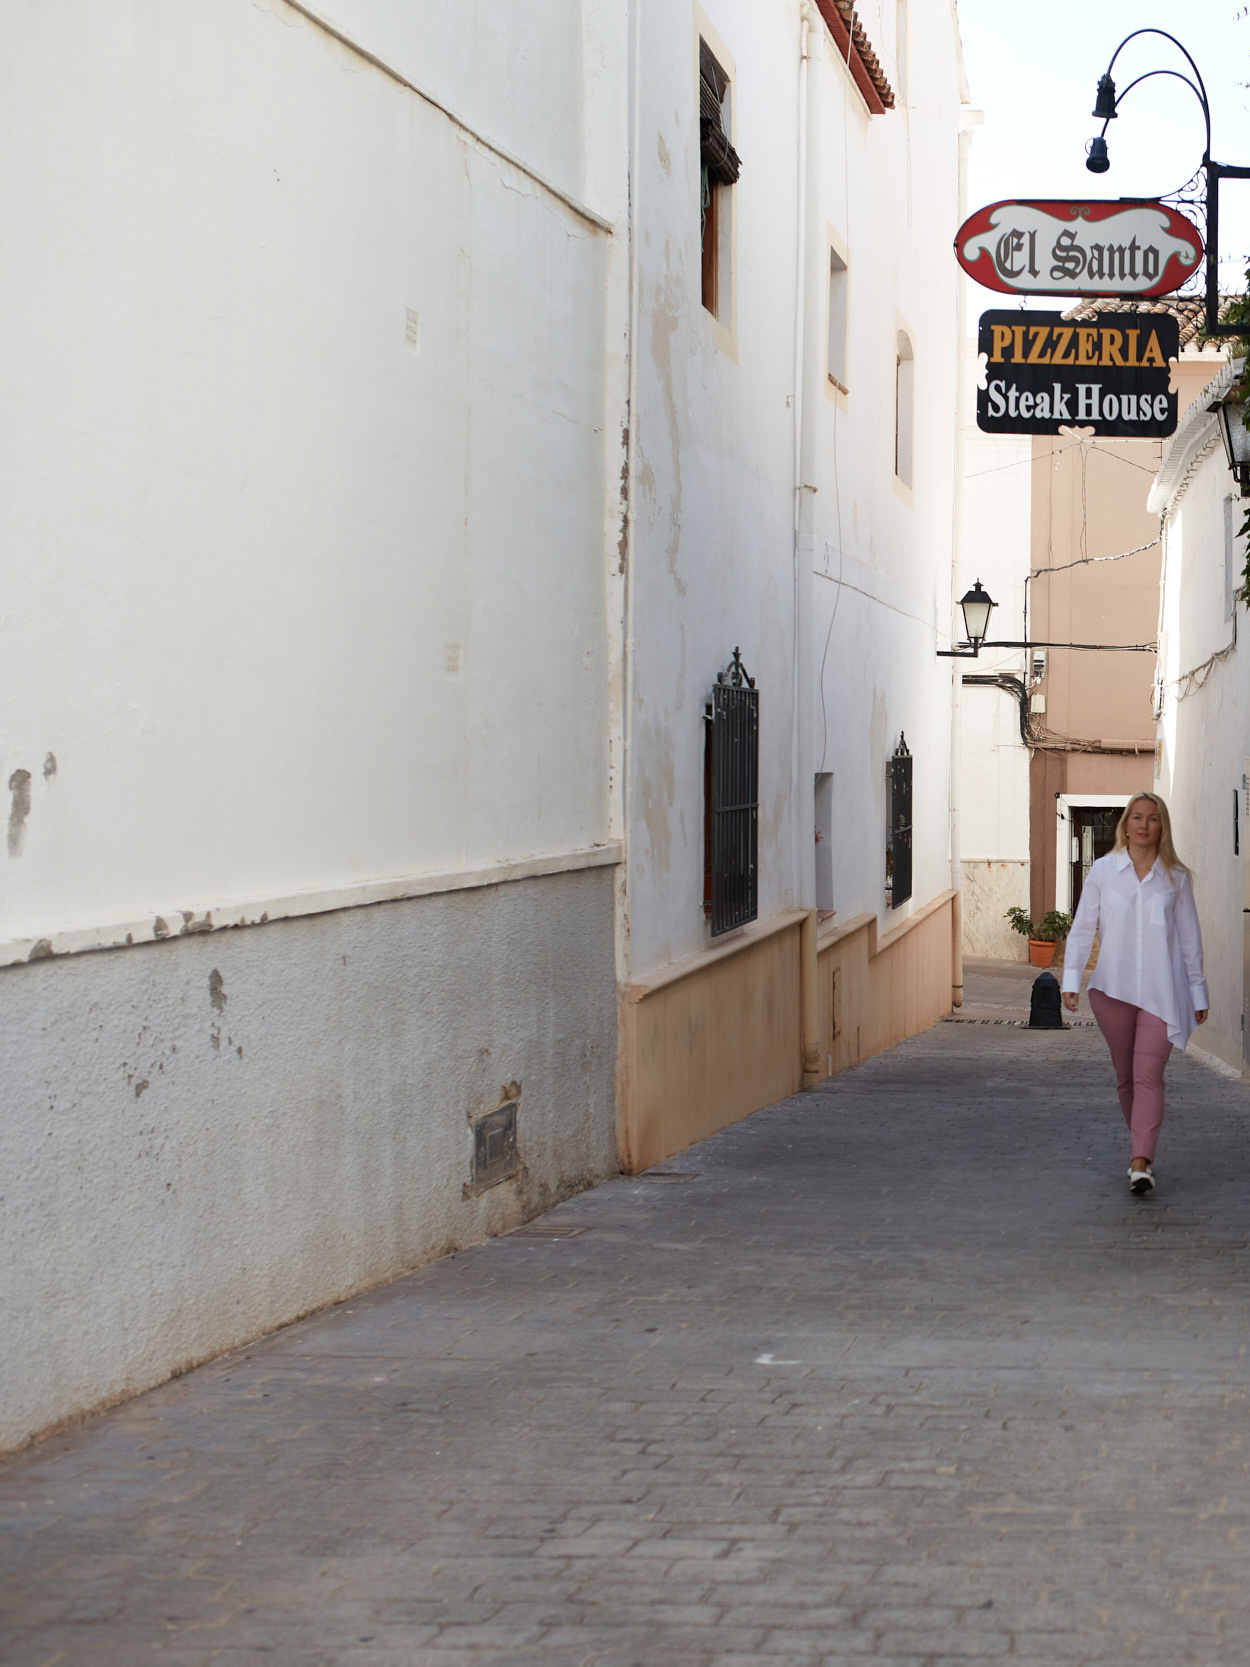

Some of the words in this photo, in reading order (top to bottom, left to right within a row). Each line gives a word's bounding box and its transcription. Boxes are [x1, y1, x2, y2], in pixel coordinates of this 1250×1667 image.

[995, 228, 1040, 279] El
[1050, 228, 1160, 281] Santo
[990, 324, 1167, 368] PIZZERIA
[987, 379, 1072, 420] Steak
[1075, 383, 1169, 421] House
